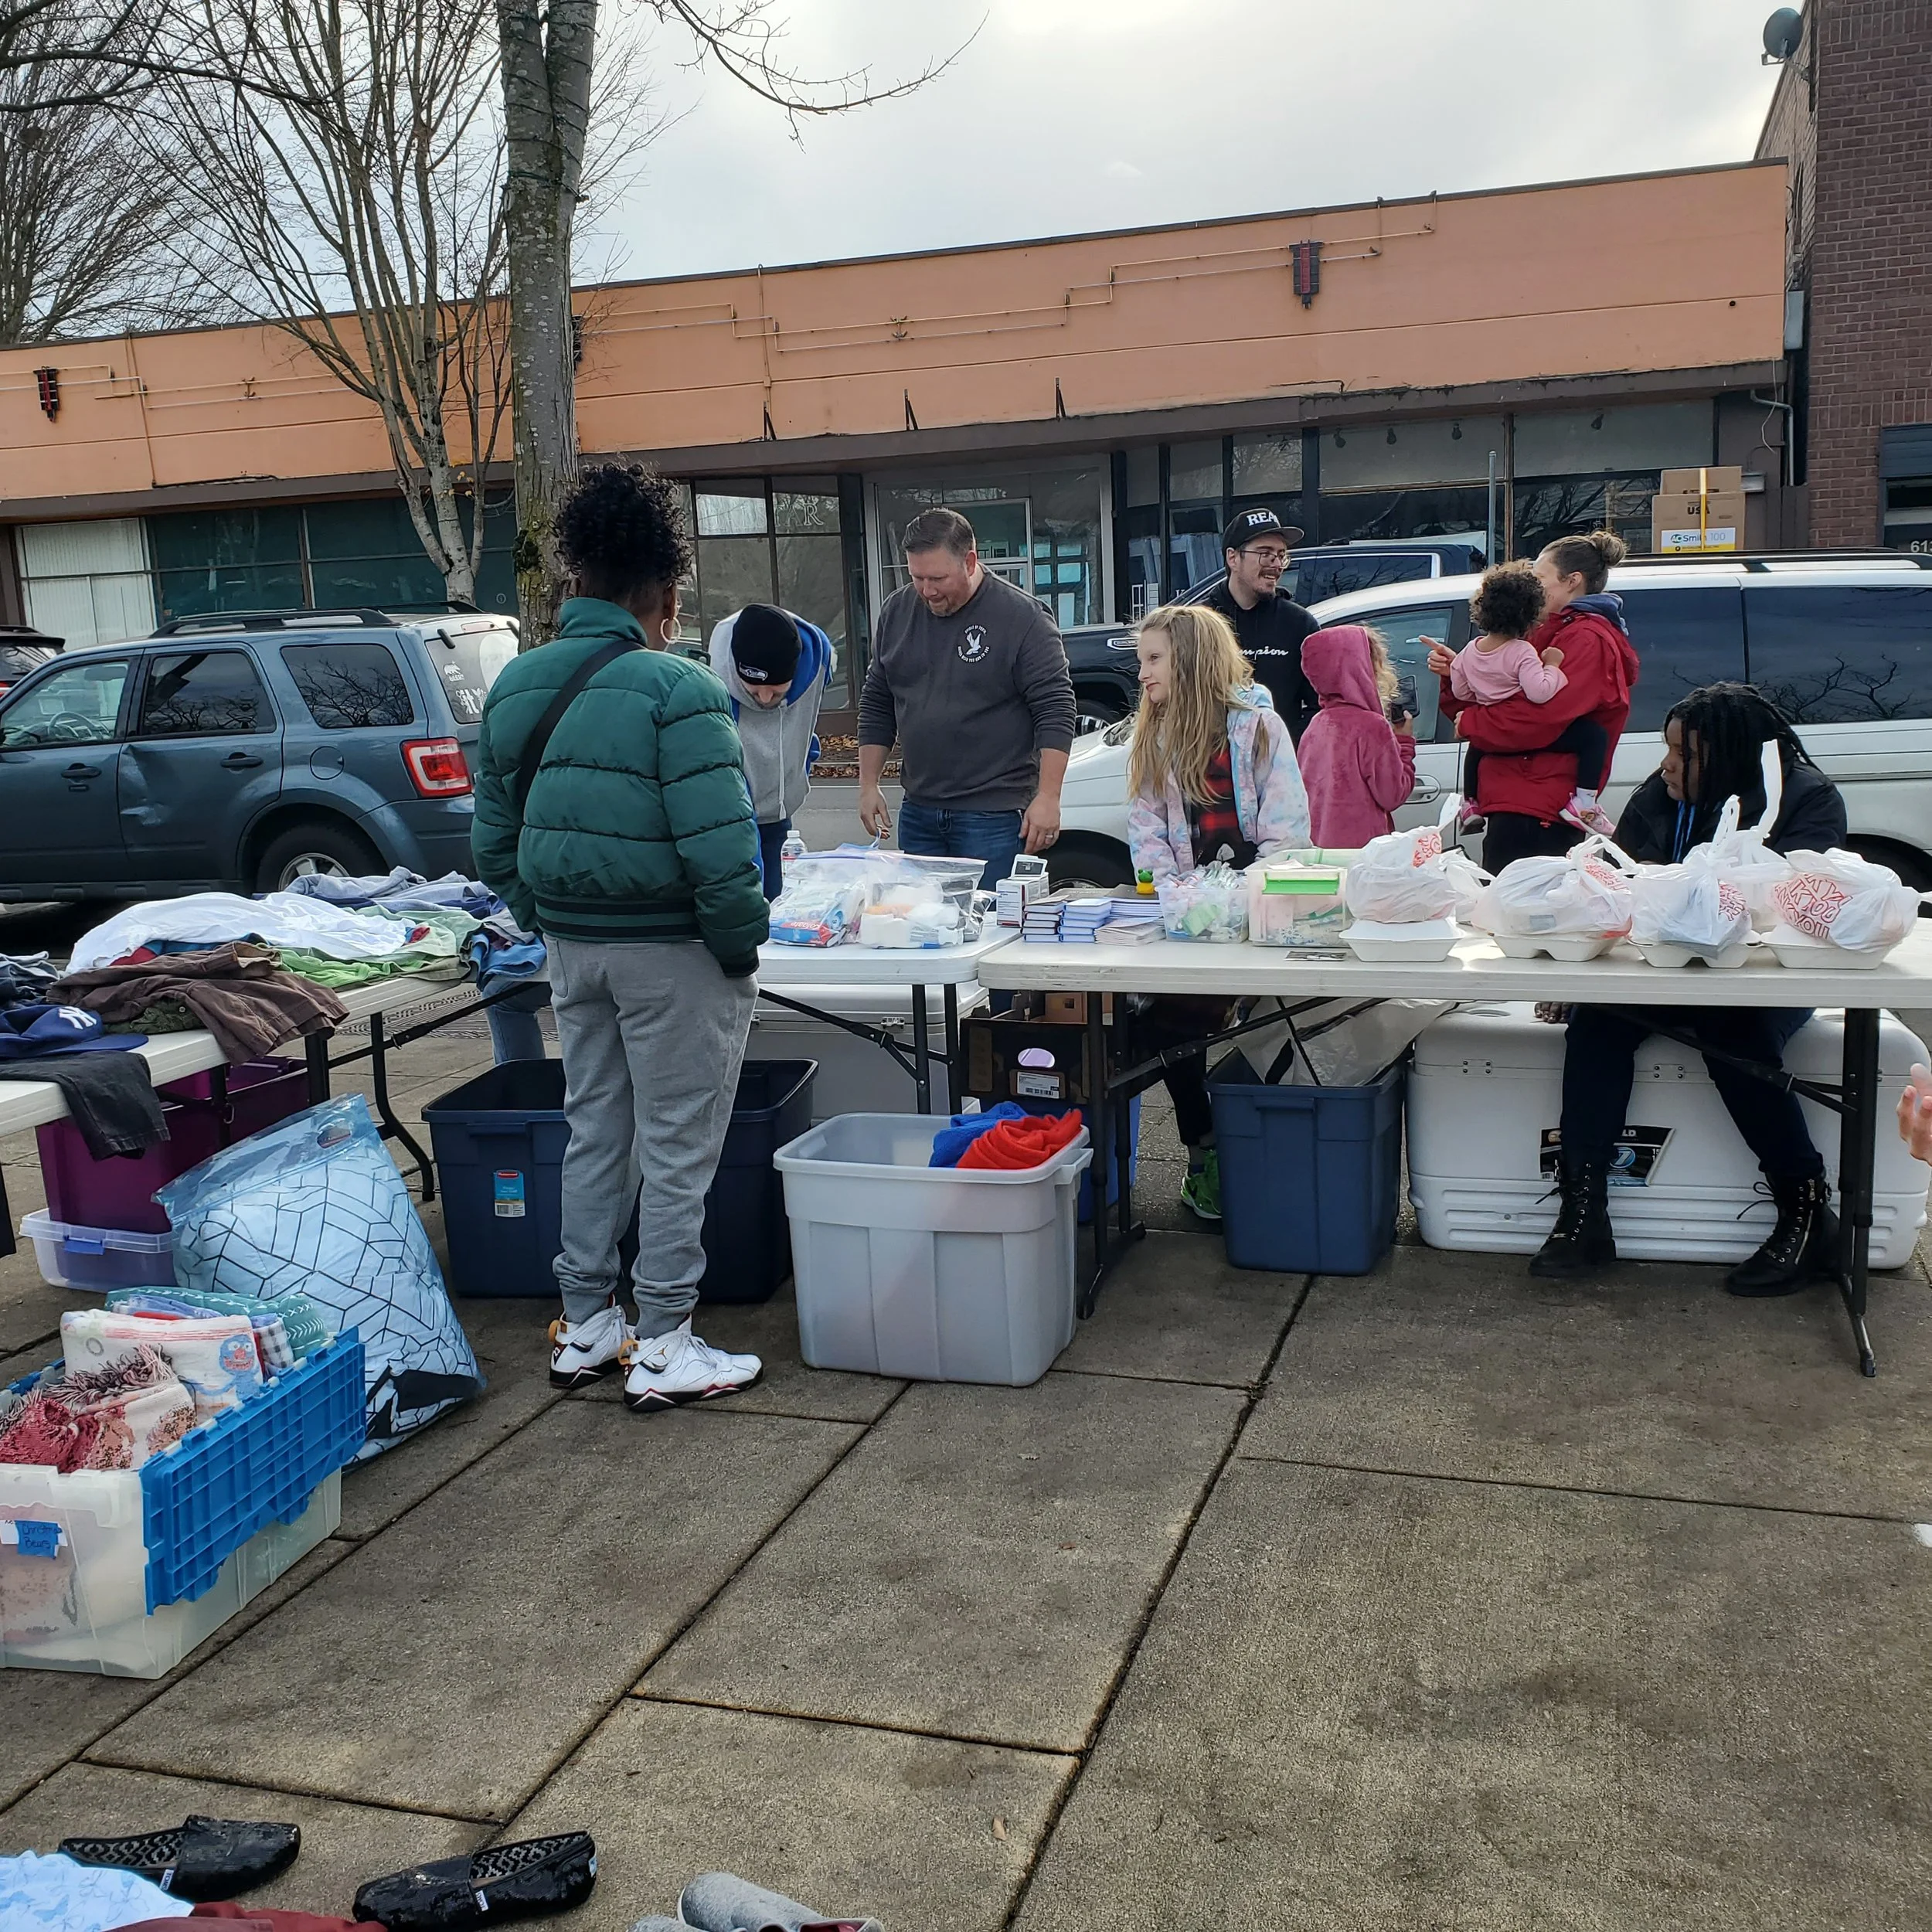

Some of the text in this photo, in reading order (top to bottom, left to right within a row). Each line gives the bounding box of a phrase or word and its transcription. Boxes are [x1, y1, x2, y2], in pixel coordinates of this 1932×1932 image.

[1247, 511, 1281, 526] REA
[1711, 532, 1726, 541] 100
[1238, 646, 1289, 660] mpion
[59, 1005, 97, 1029] NY
